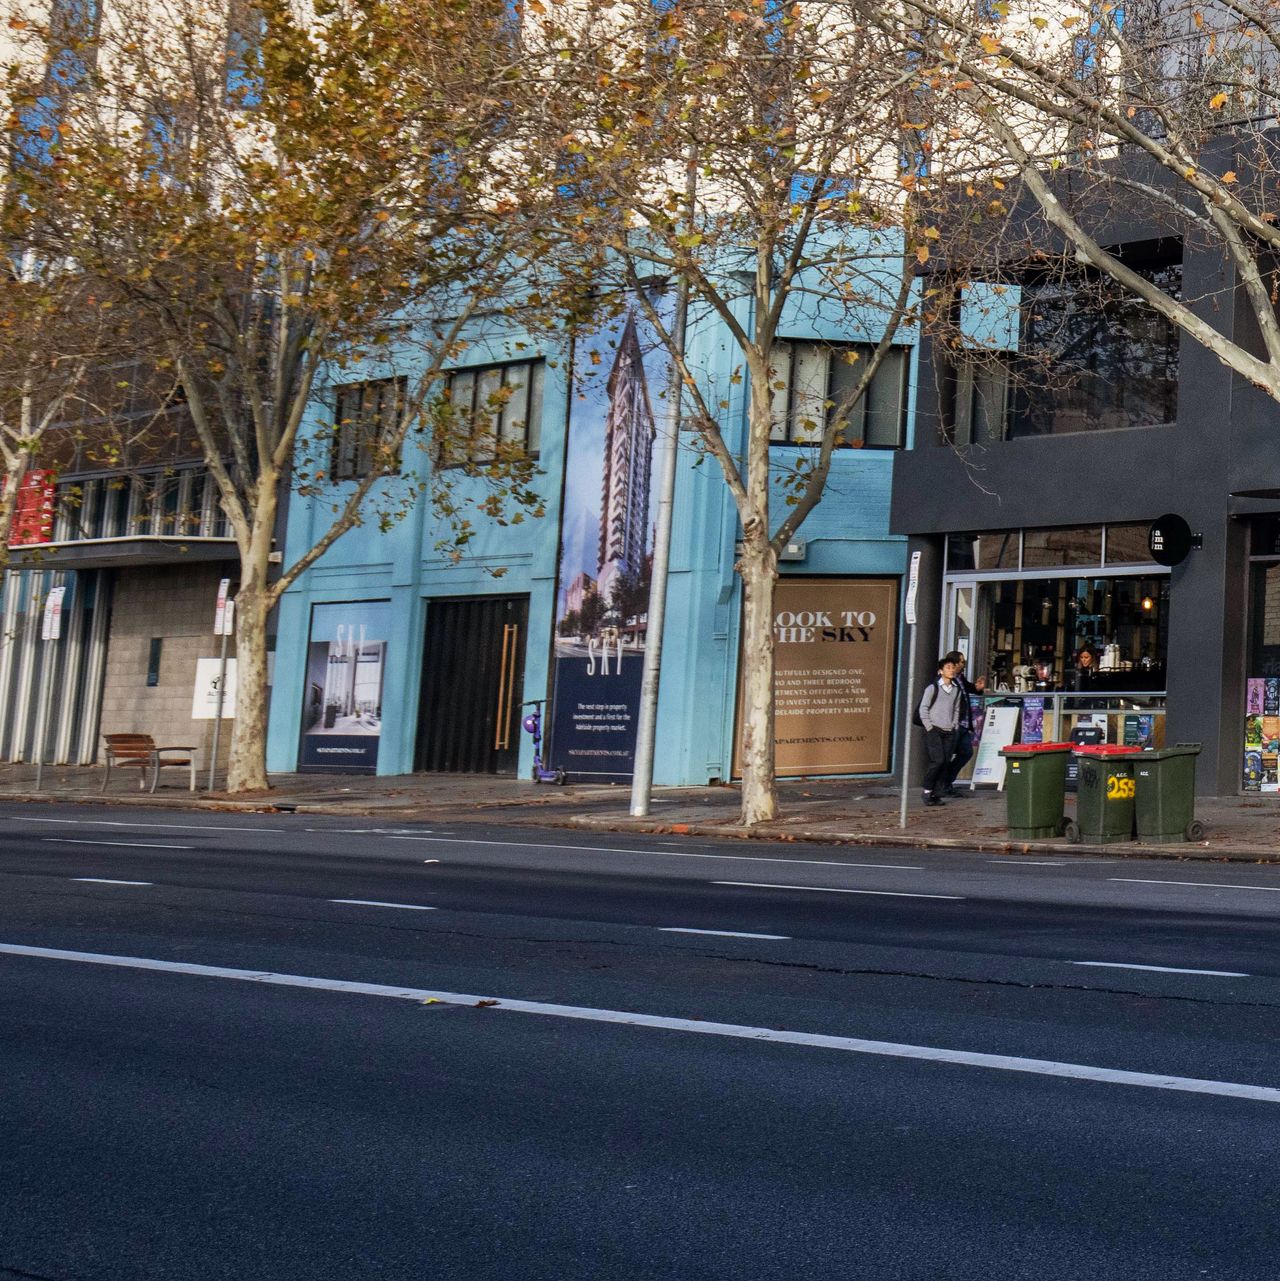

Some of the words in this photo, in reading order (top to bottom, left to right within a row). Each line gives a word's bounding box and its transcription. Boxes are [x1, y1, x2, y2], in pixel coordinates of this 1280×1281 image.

[841, 611, 876, 626] TO
[822, 627, 874, 642] SKY
[587, 638, 624, 675] SKY
